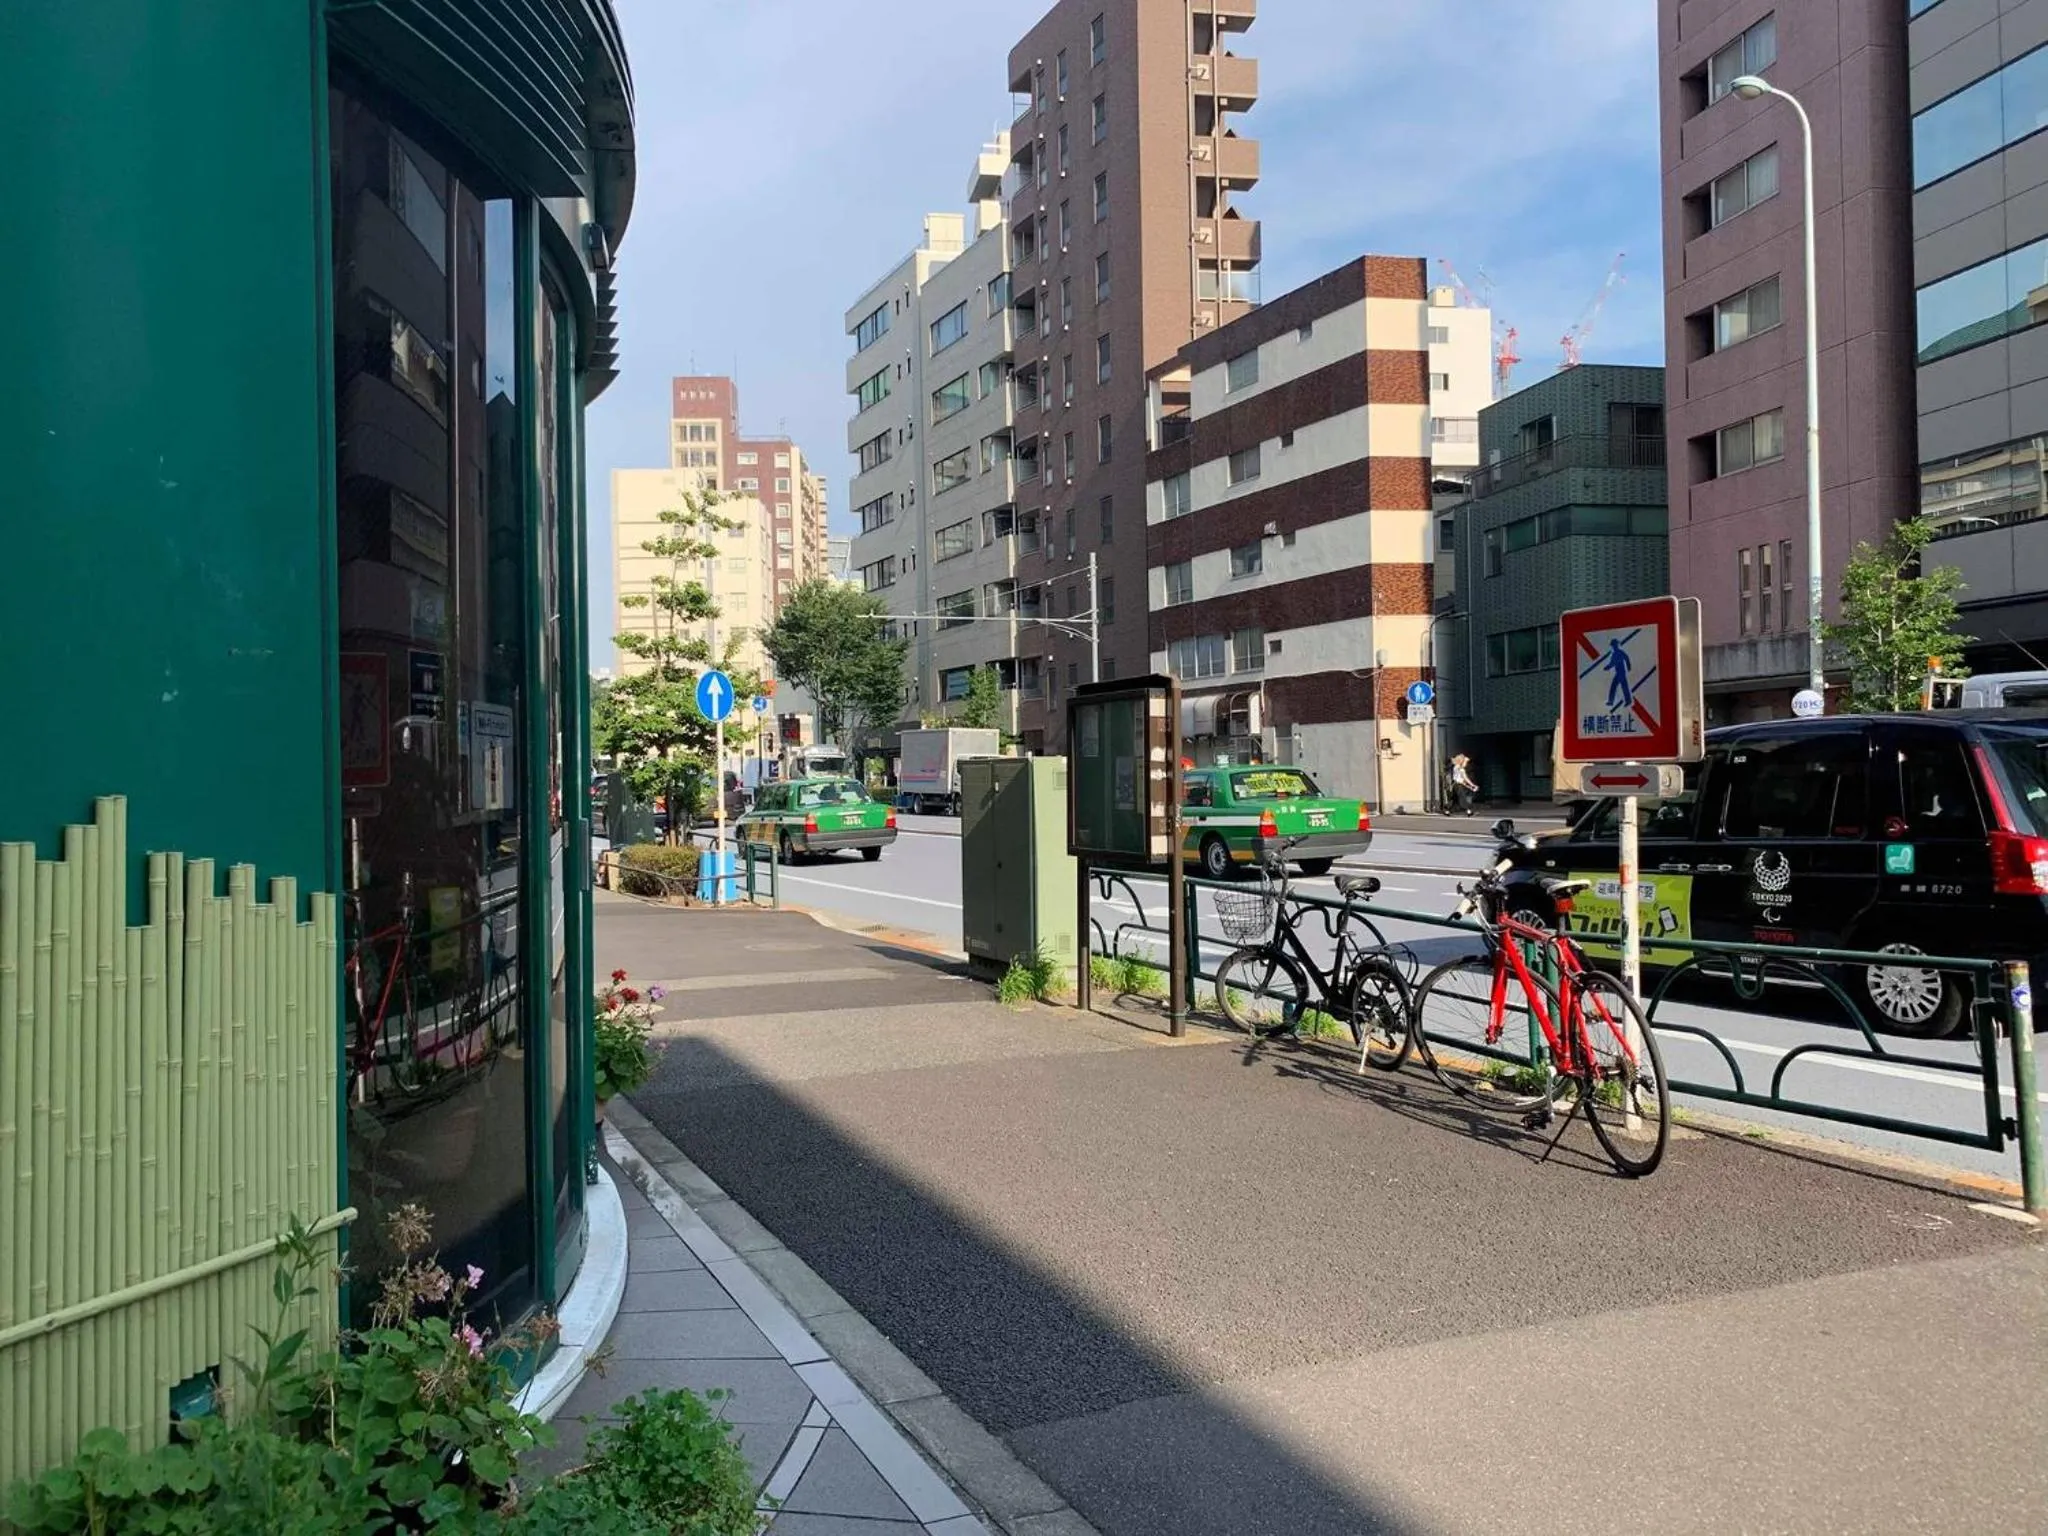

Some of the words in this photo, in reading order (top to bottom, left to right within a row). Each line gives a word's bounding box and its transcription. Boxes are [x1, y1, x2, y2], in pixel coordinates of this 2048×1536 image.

[1582, 713, 1637, 735] 横断禁止
[1752, 893, 1774, 902] TOKYO
[1775, 894, 1793, 903] 2020
